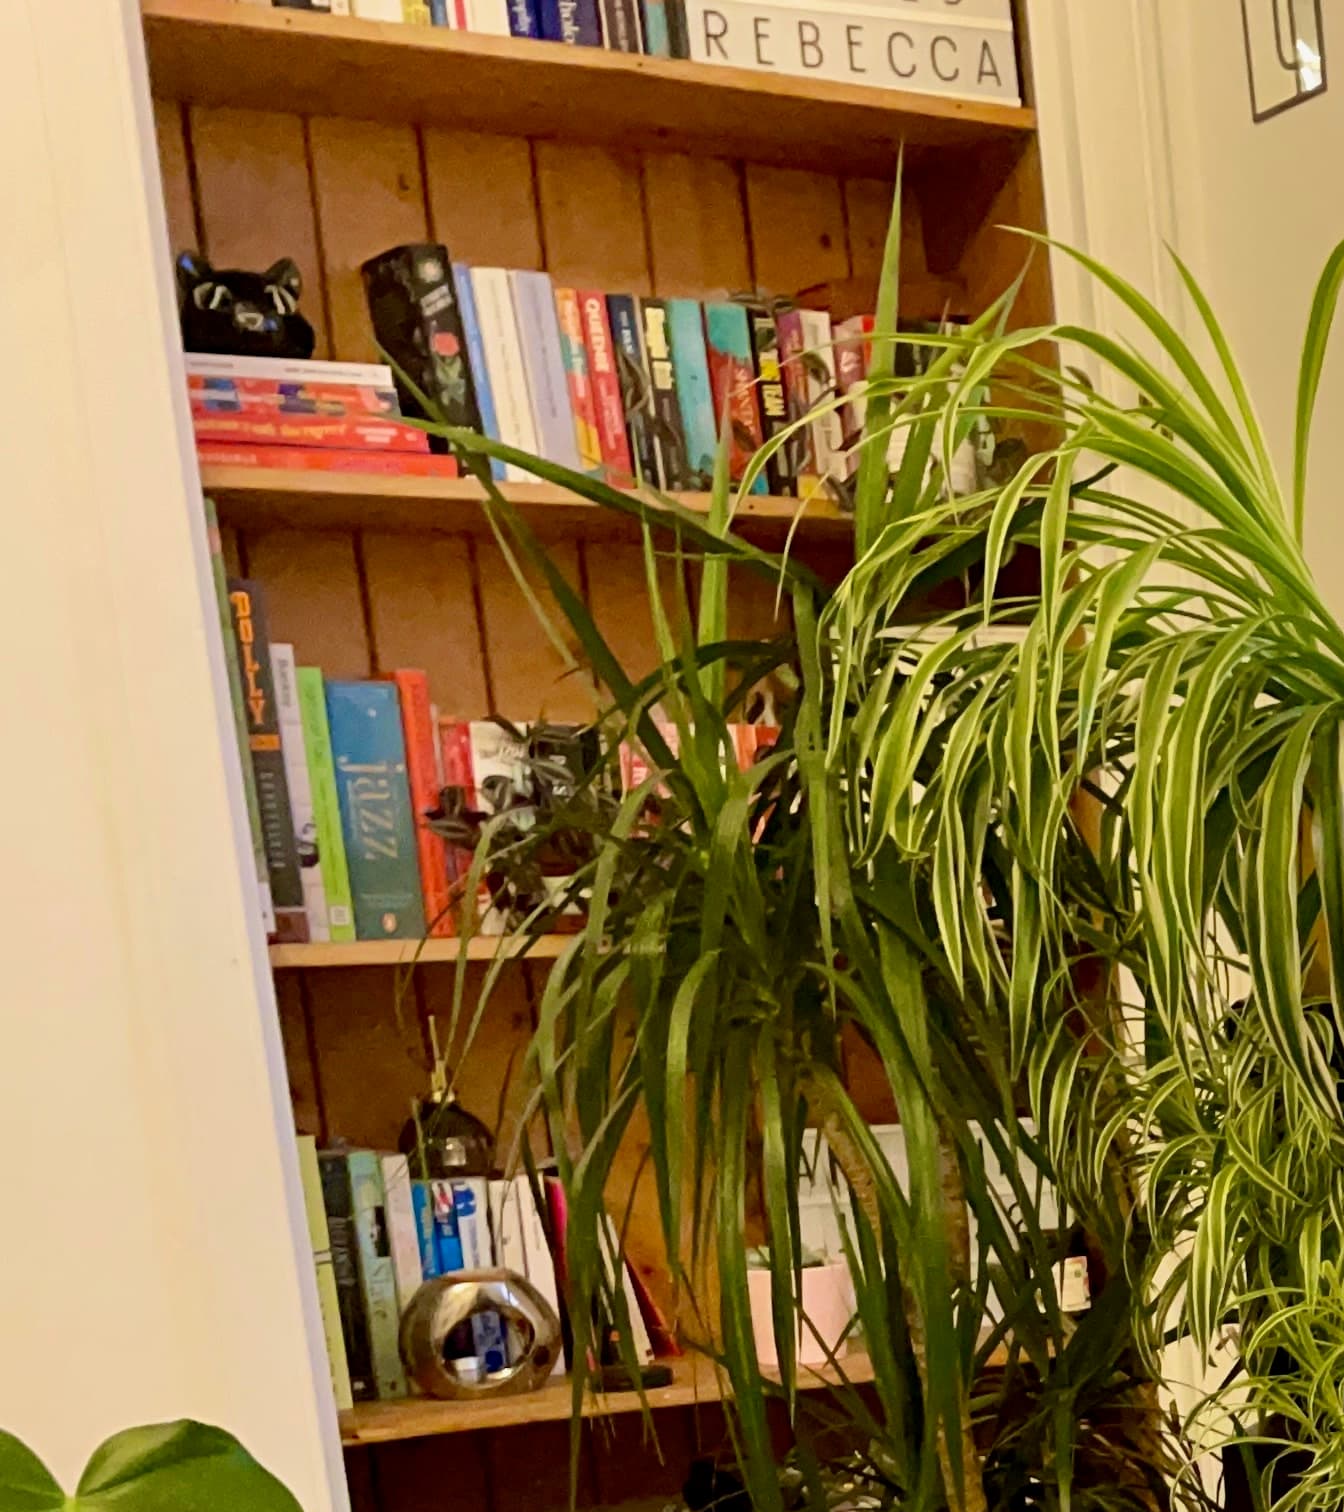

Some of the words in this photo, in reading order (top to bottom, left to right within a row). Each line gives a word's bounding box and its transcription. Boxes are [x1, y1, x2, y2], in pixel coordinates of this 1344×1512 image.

[703, 9, 1002, 87] REBECCA
[231, 592, 265, 725] DOLLY
[338, 754, 405, 861] jazz
